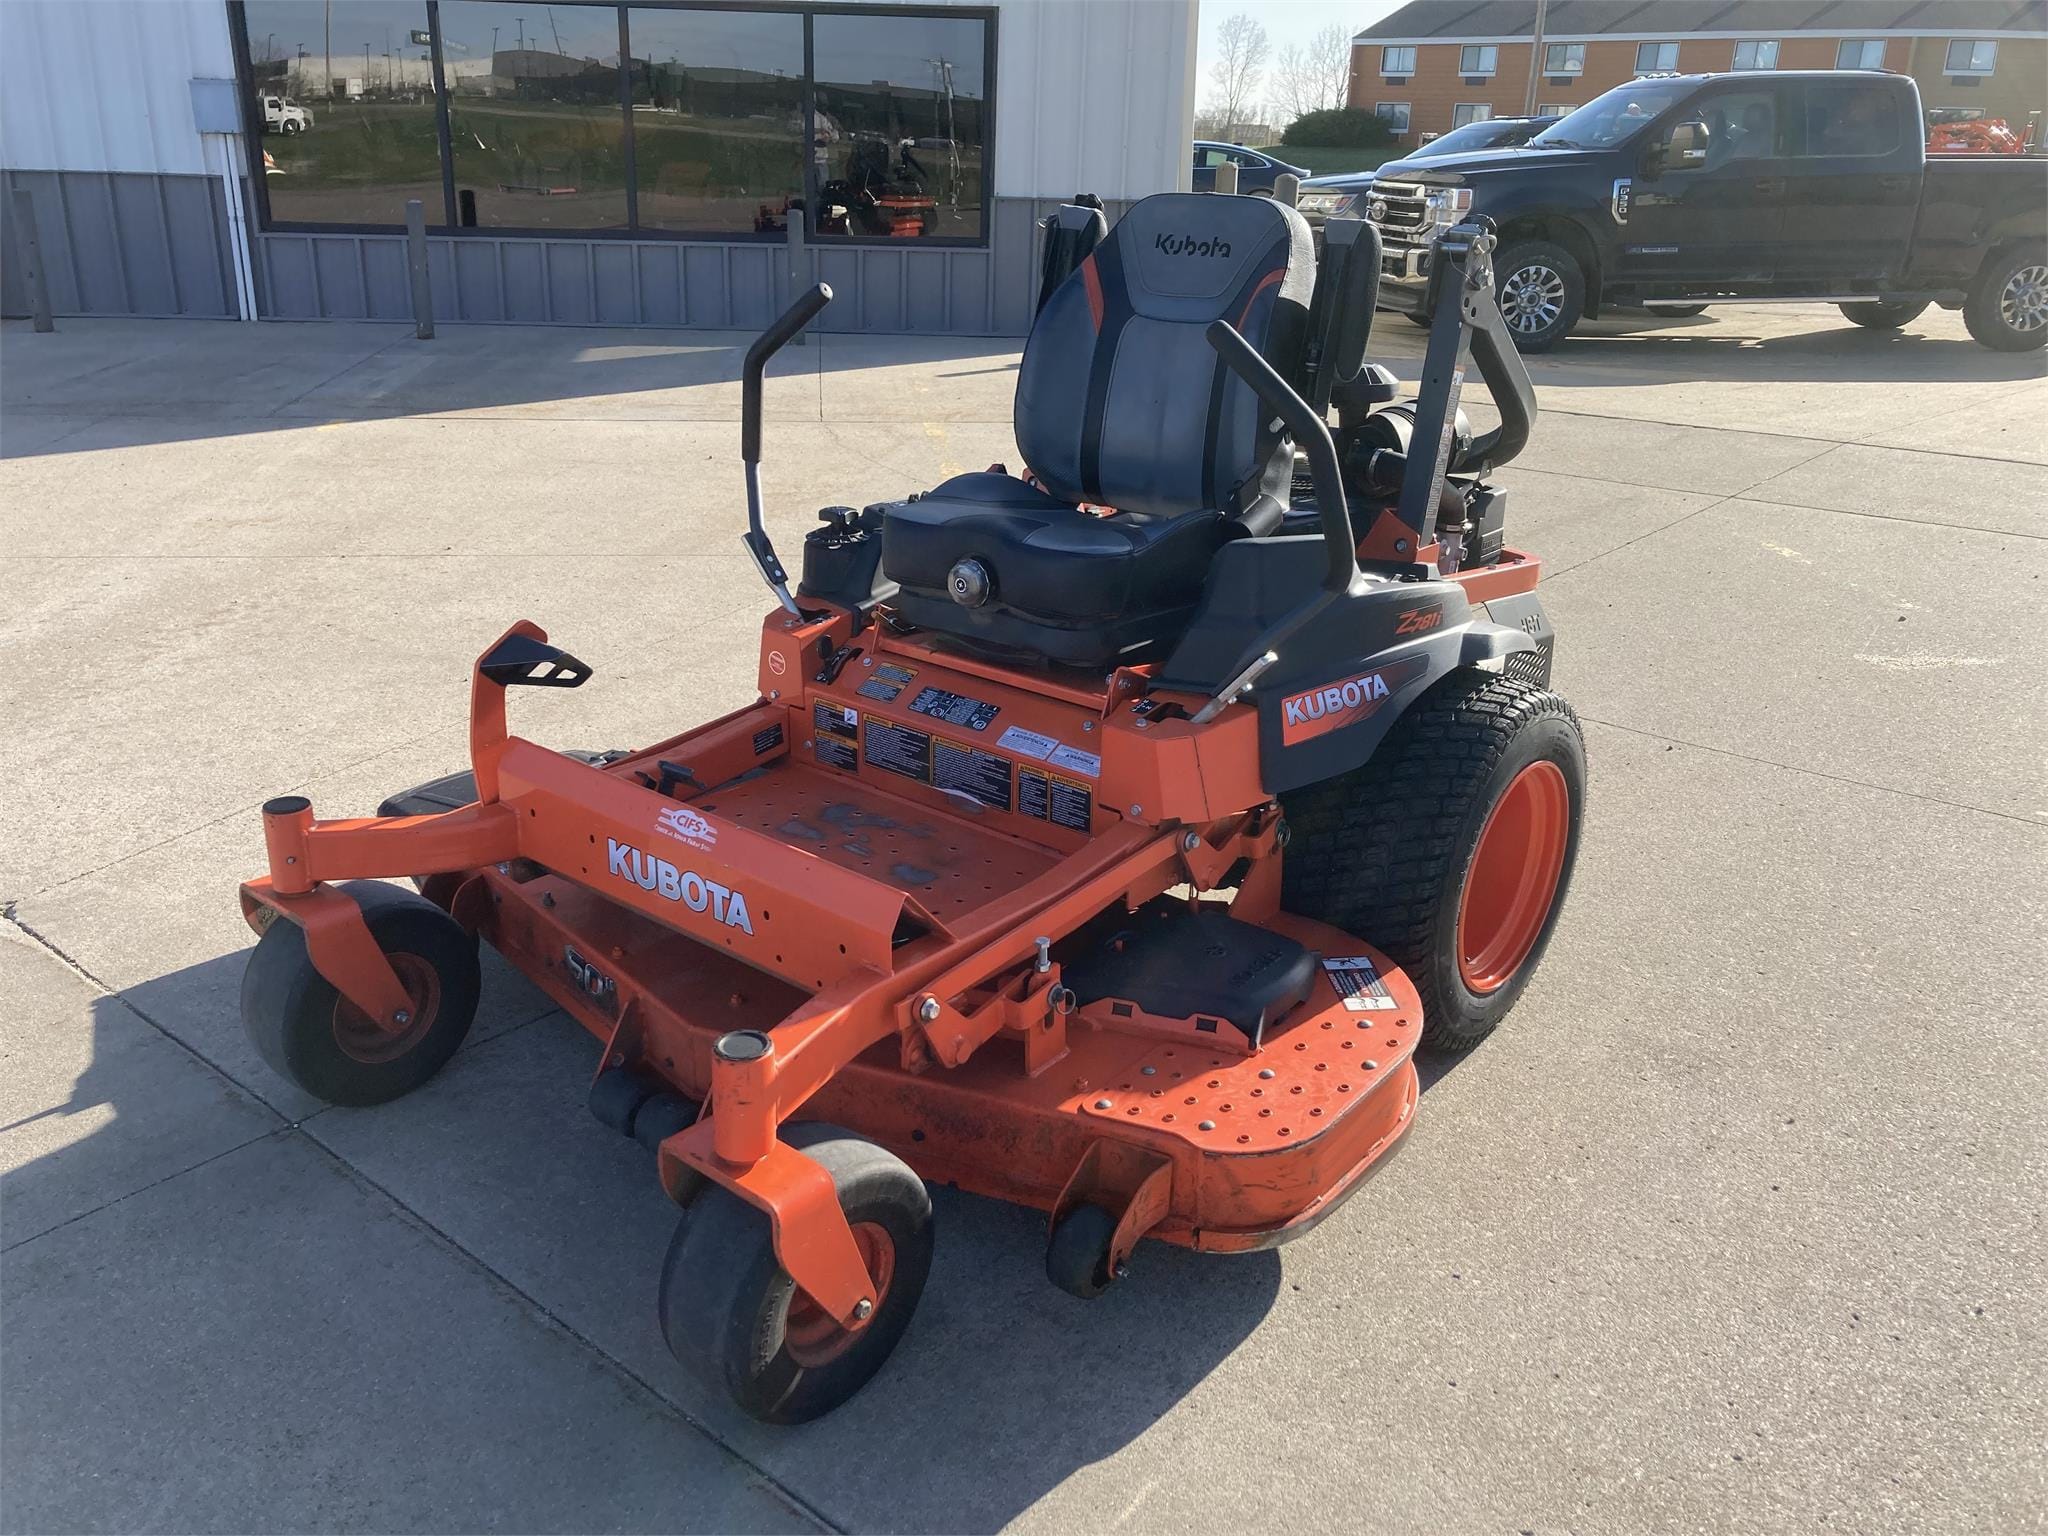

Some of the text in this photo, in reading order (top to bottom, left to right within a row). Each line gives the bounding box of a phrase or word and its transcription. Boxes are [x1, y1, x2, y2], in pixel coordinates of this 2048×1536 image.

[1154, 232, 1233, 258] Kubota
[1285, 673, 1391, 727] KUBOTA
[676, 814, 704, 833] CIFS
[607, 836, 755, 936] KUBOTA
